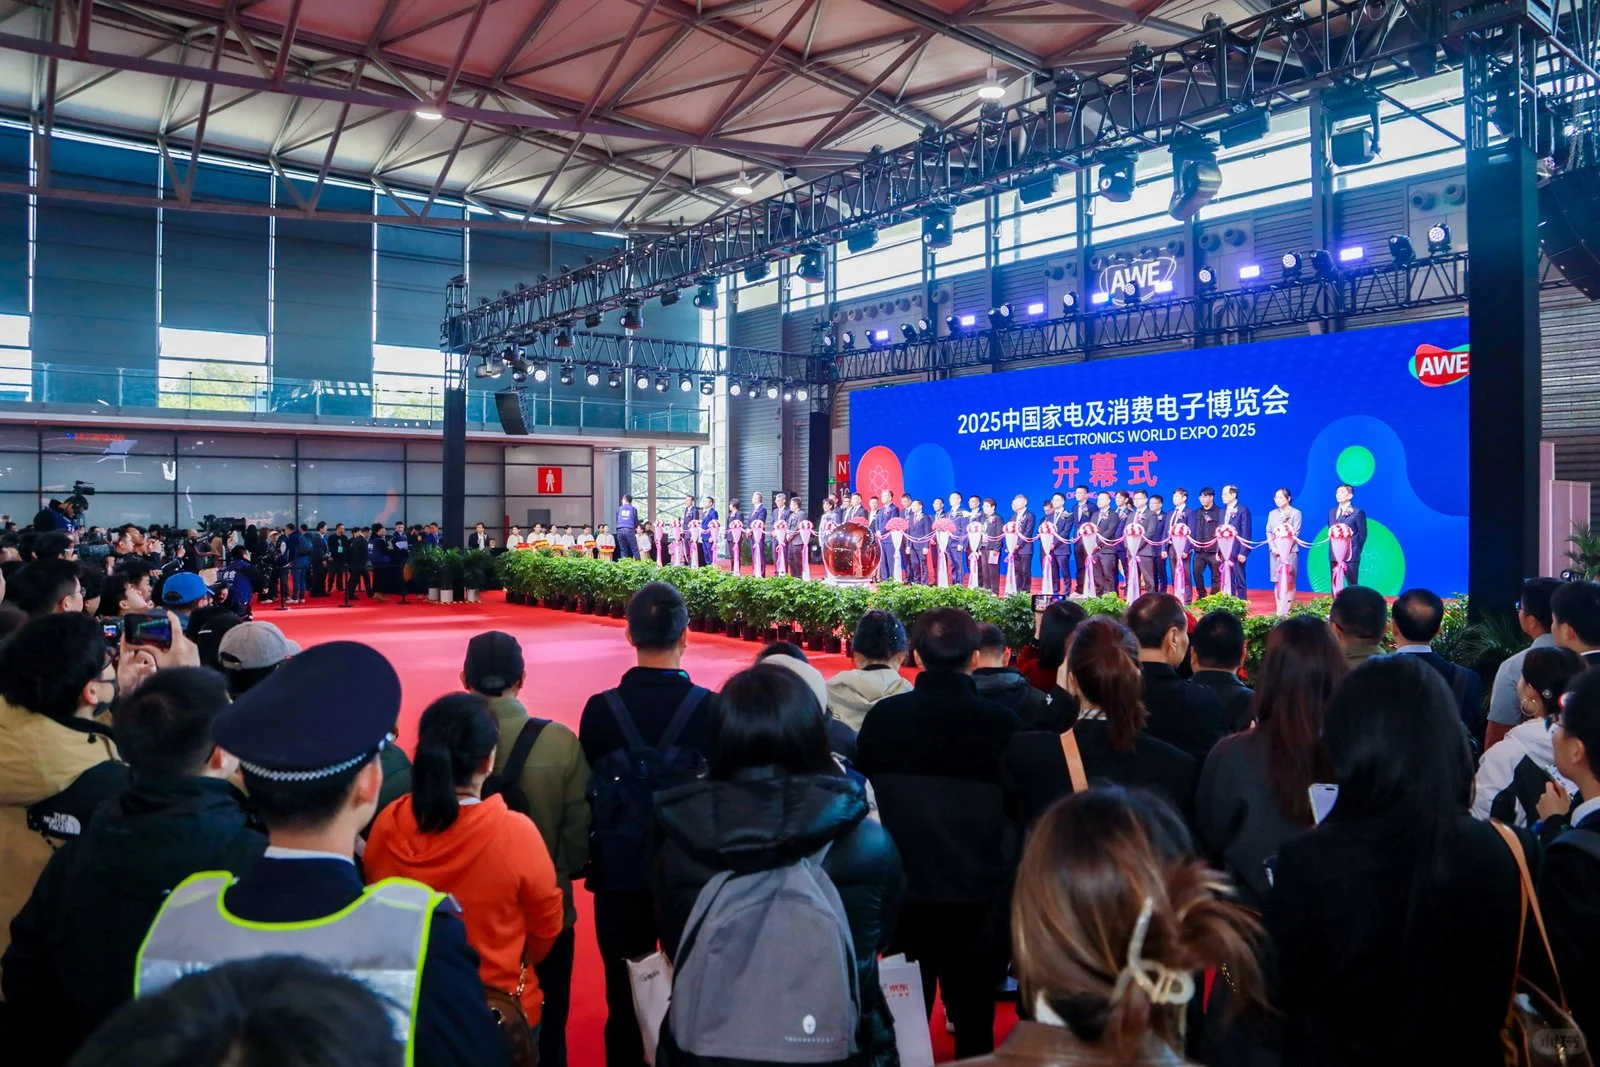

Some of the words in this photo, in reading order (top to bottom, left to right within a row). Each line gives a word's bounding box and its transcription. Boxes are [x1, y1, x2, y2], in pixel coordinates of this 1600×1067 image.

[1111, 261, 1161, 294] AWE
[1419, 353, 1469, 376] AWE
[957, 384, 1290, 434] 2025中国家电及消费电子博览会
[979, 431, 1125, 451] APPLIANCE&ELECTRONICS
[1127, 427, 1177, 443] WORLD
[1180, 425, 1218, 440] EXPO
[1221, 423, 1256, 437] 2025
[1053, 450, 1158, 488] 开幕式
